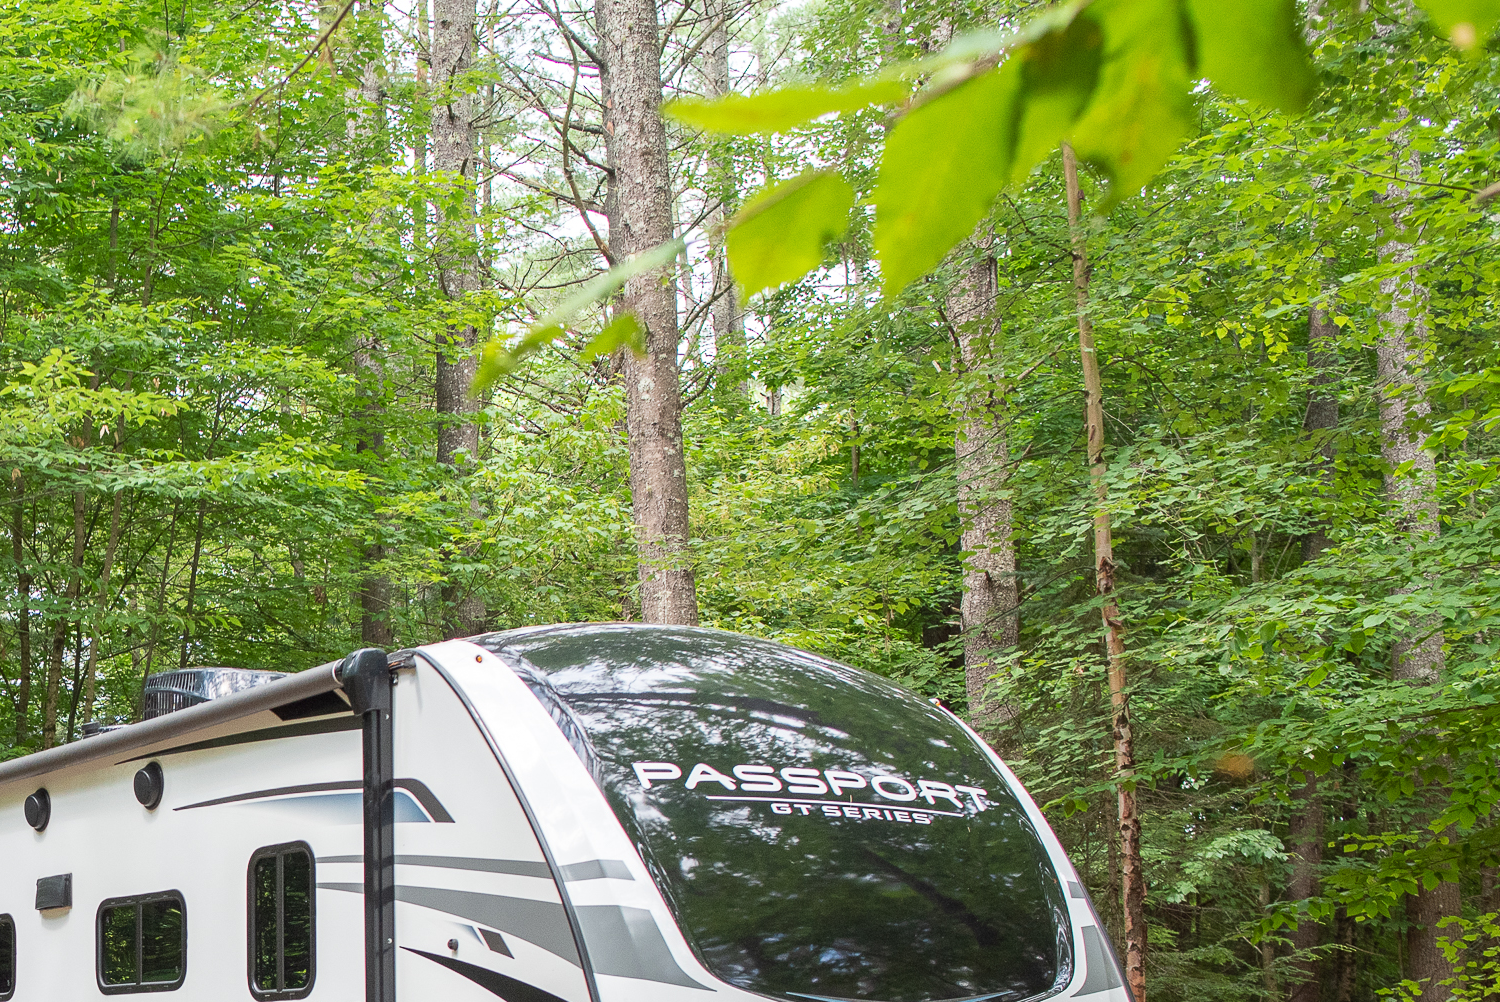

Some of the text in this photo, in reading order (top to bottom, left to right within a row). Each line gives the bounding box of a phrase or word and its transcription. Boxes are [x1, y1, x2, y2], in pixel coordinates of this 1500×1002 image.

[632, 761, 989, 812] PASSPORT
[771, 802, 931, 825] GT SERIES
